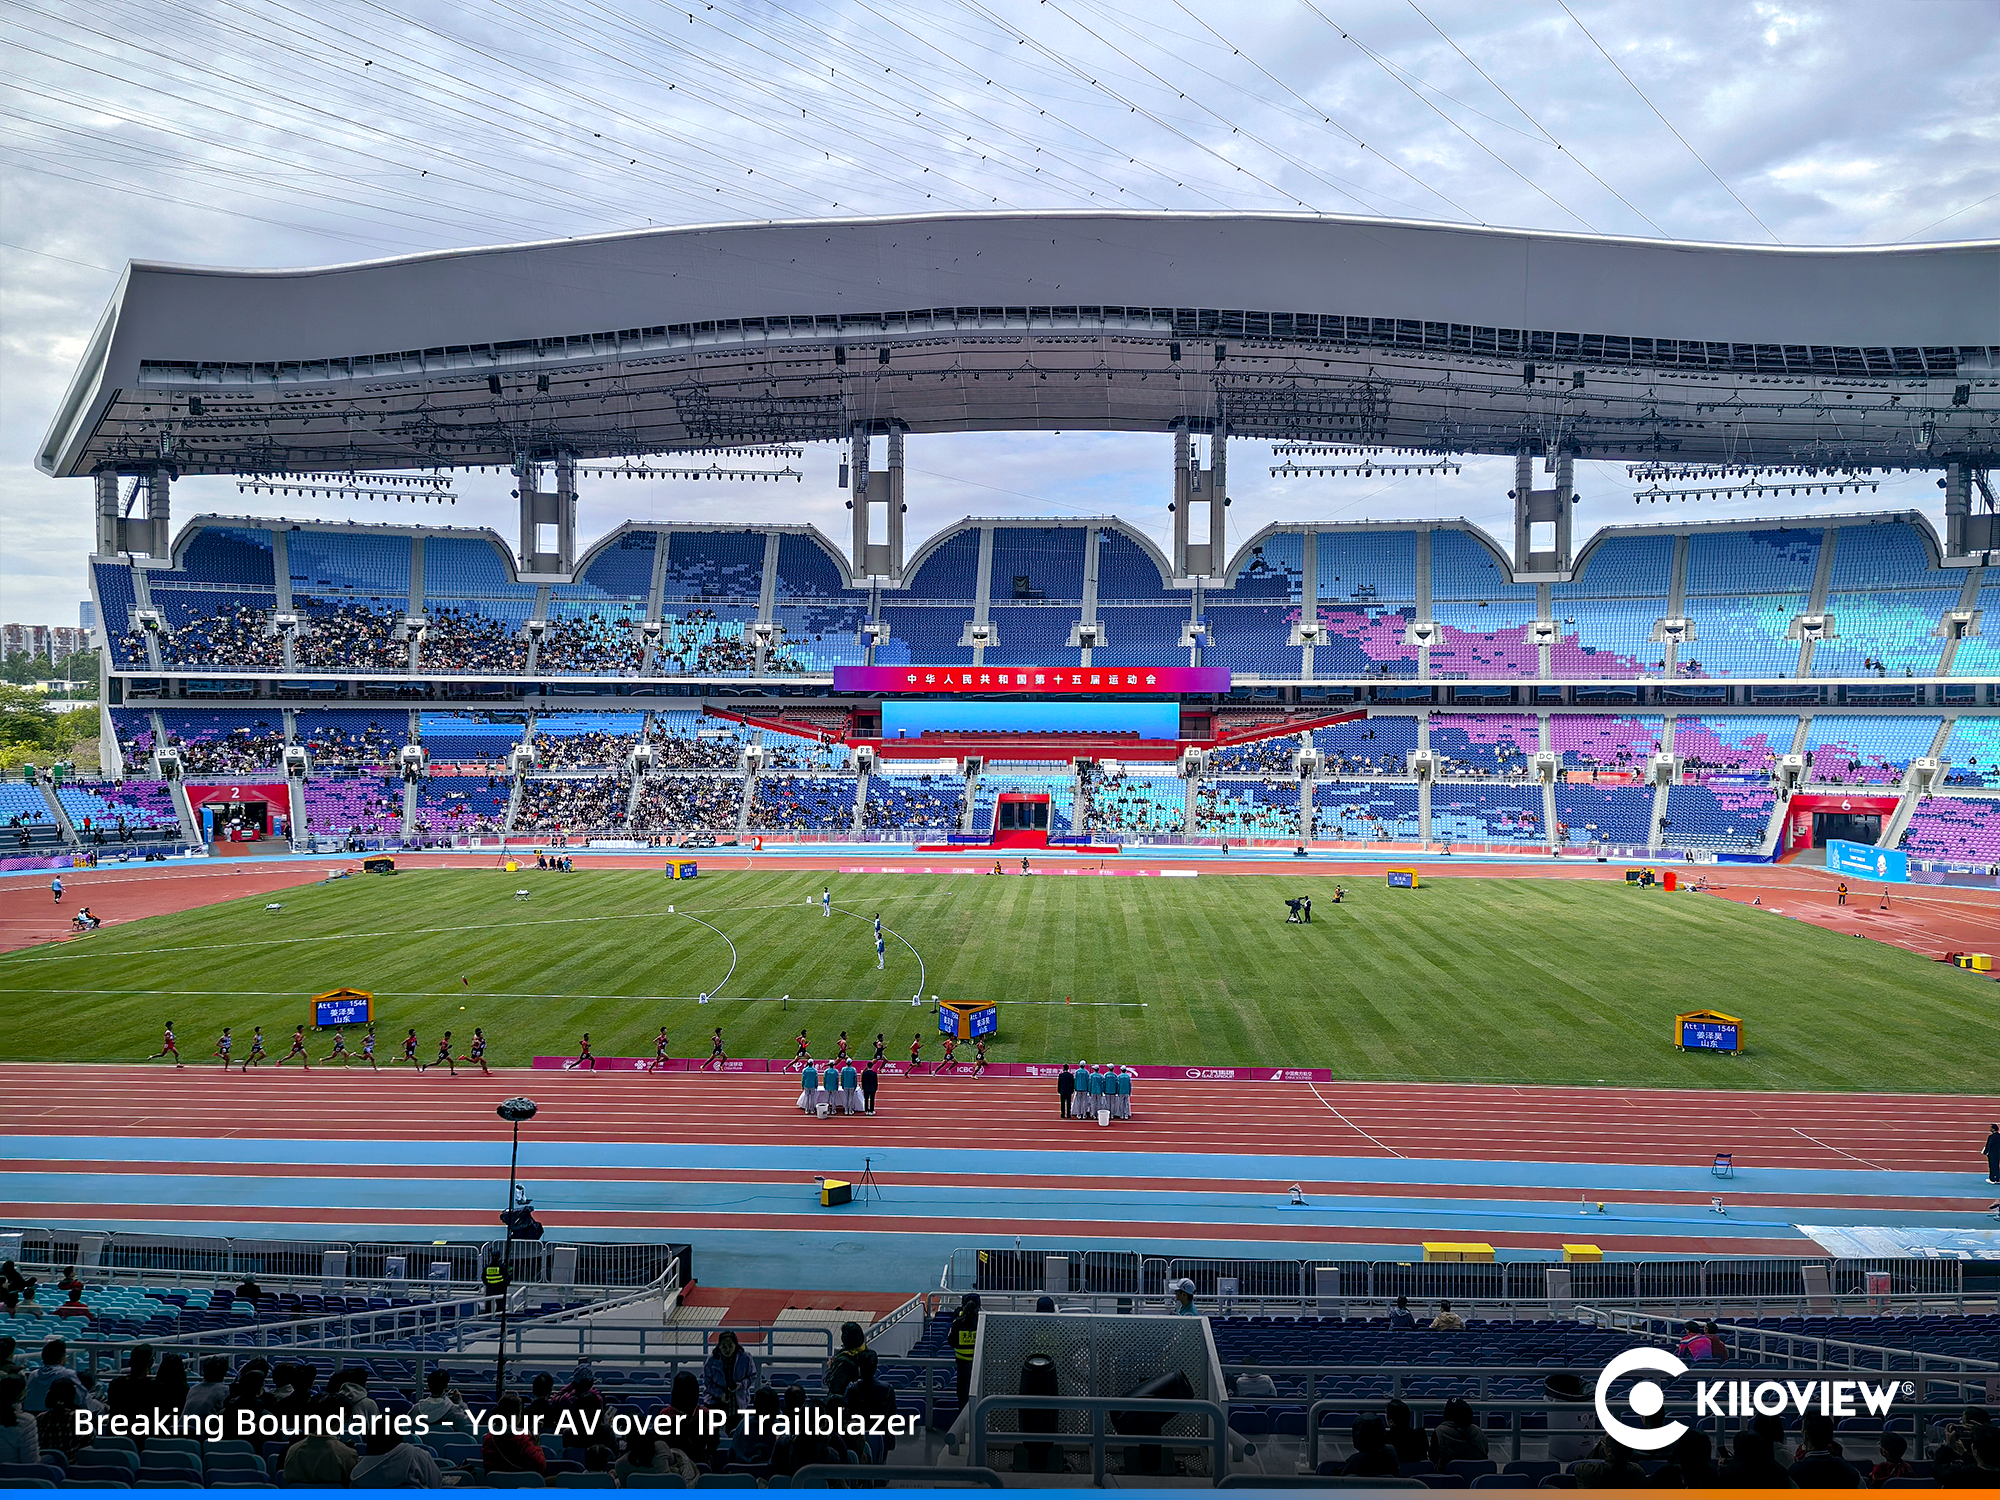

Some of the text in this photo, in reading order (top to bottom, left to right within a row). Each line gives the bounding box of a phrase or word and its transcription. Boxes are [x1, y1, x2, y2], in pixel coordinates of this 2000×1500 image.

[907, 673, 1157, 685] 中华人民共和国第十五届运动会
[231, 787, 240, 799] 2
[1841, 799, 1851, 811] 6
[349, 999, 367, 1007] 1544
[1700, 1040, 1718, 1048] 山东
